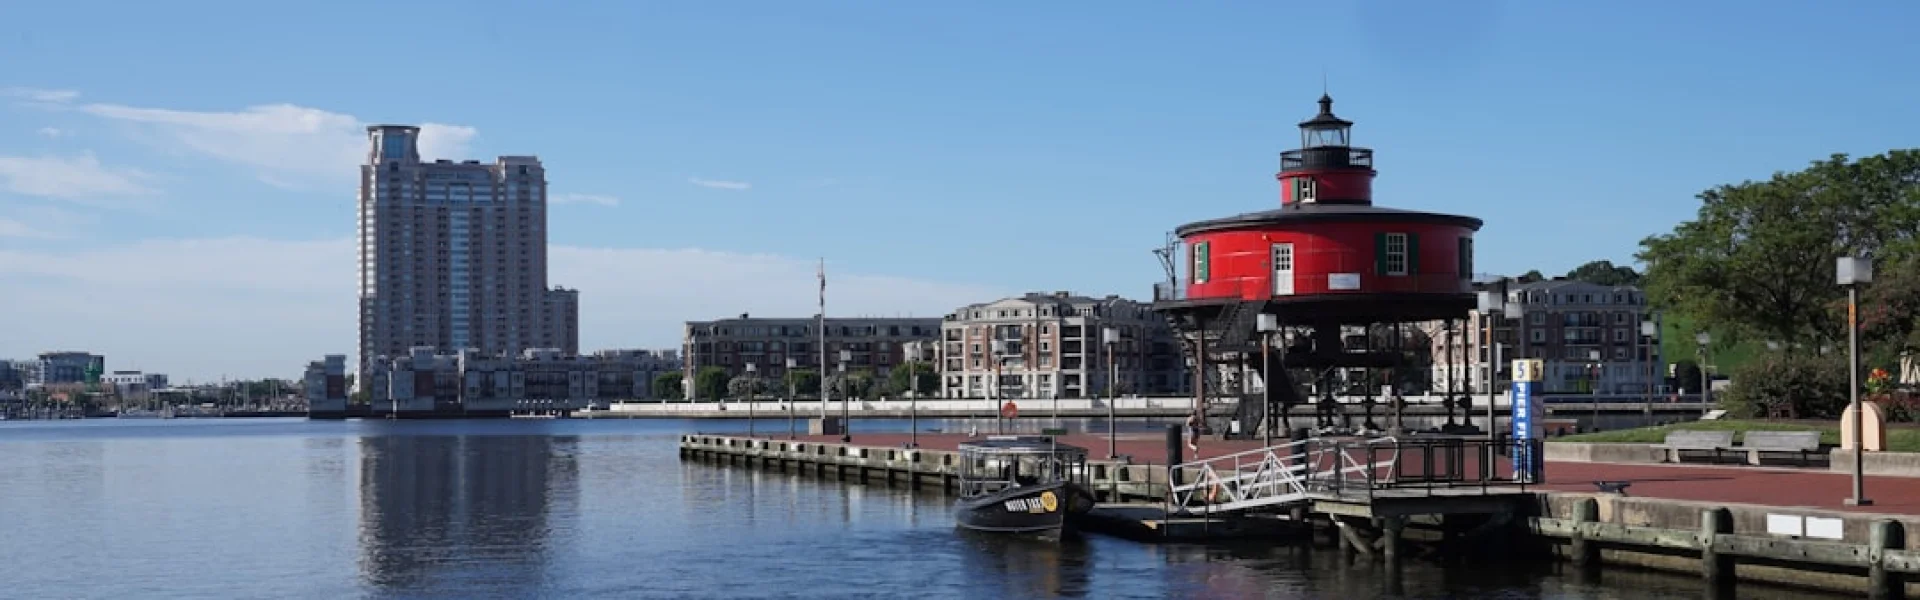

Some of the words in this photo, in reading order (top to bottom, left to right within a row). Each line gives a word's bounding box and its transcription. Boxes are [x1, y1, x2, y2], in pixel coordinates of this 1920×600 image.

[1517, 361, 1525, 379] 5
[1532, 362, 1540, 379] 5
[1516, 382, 1527, 418] PIER
